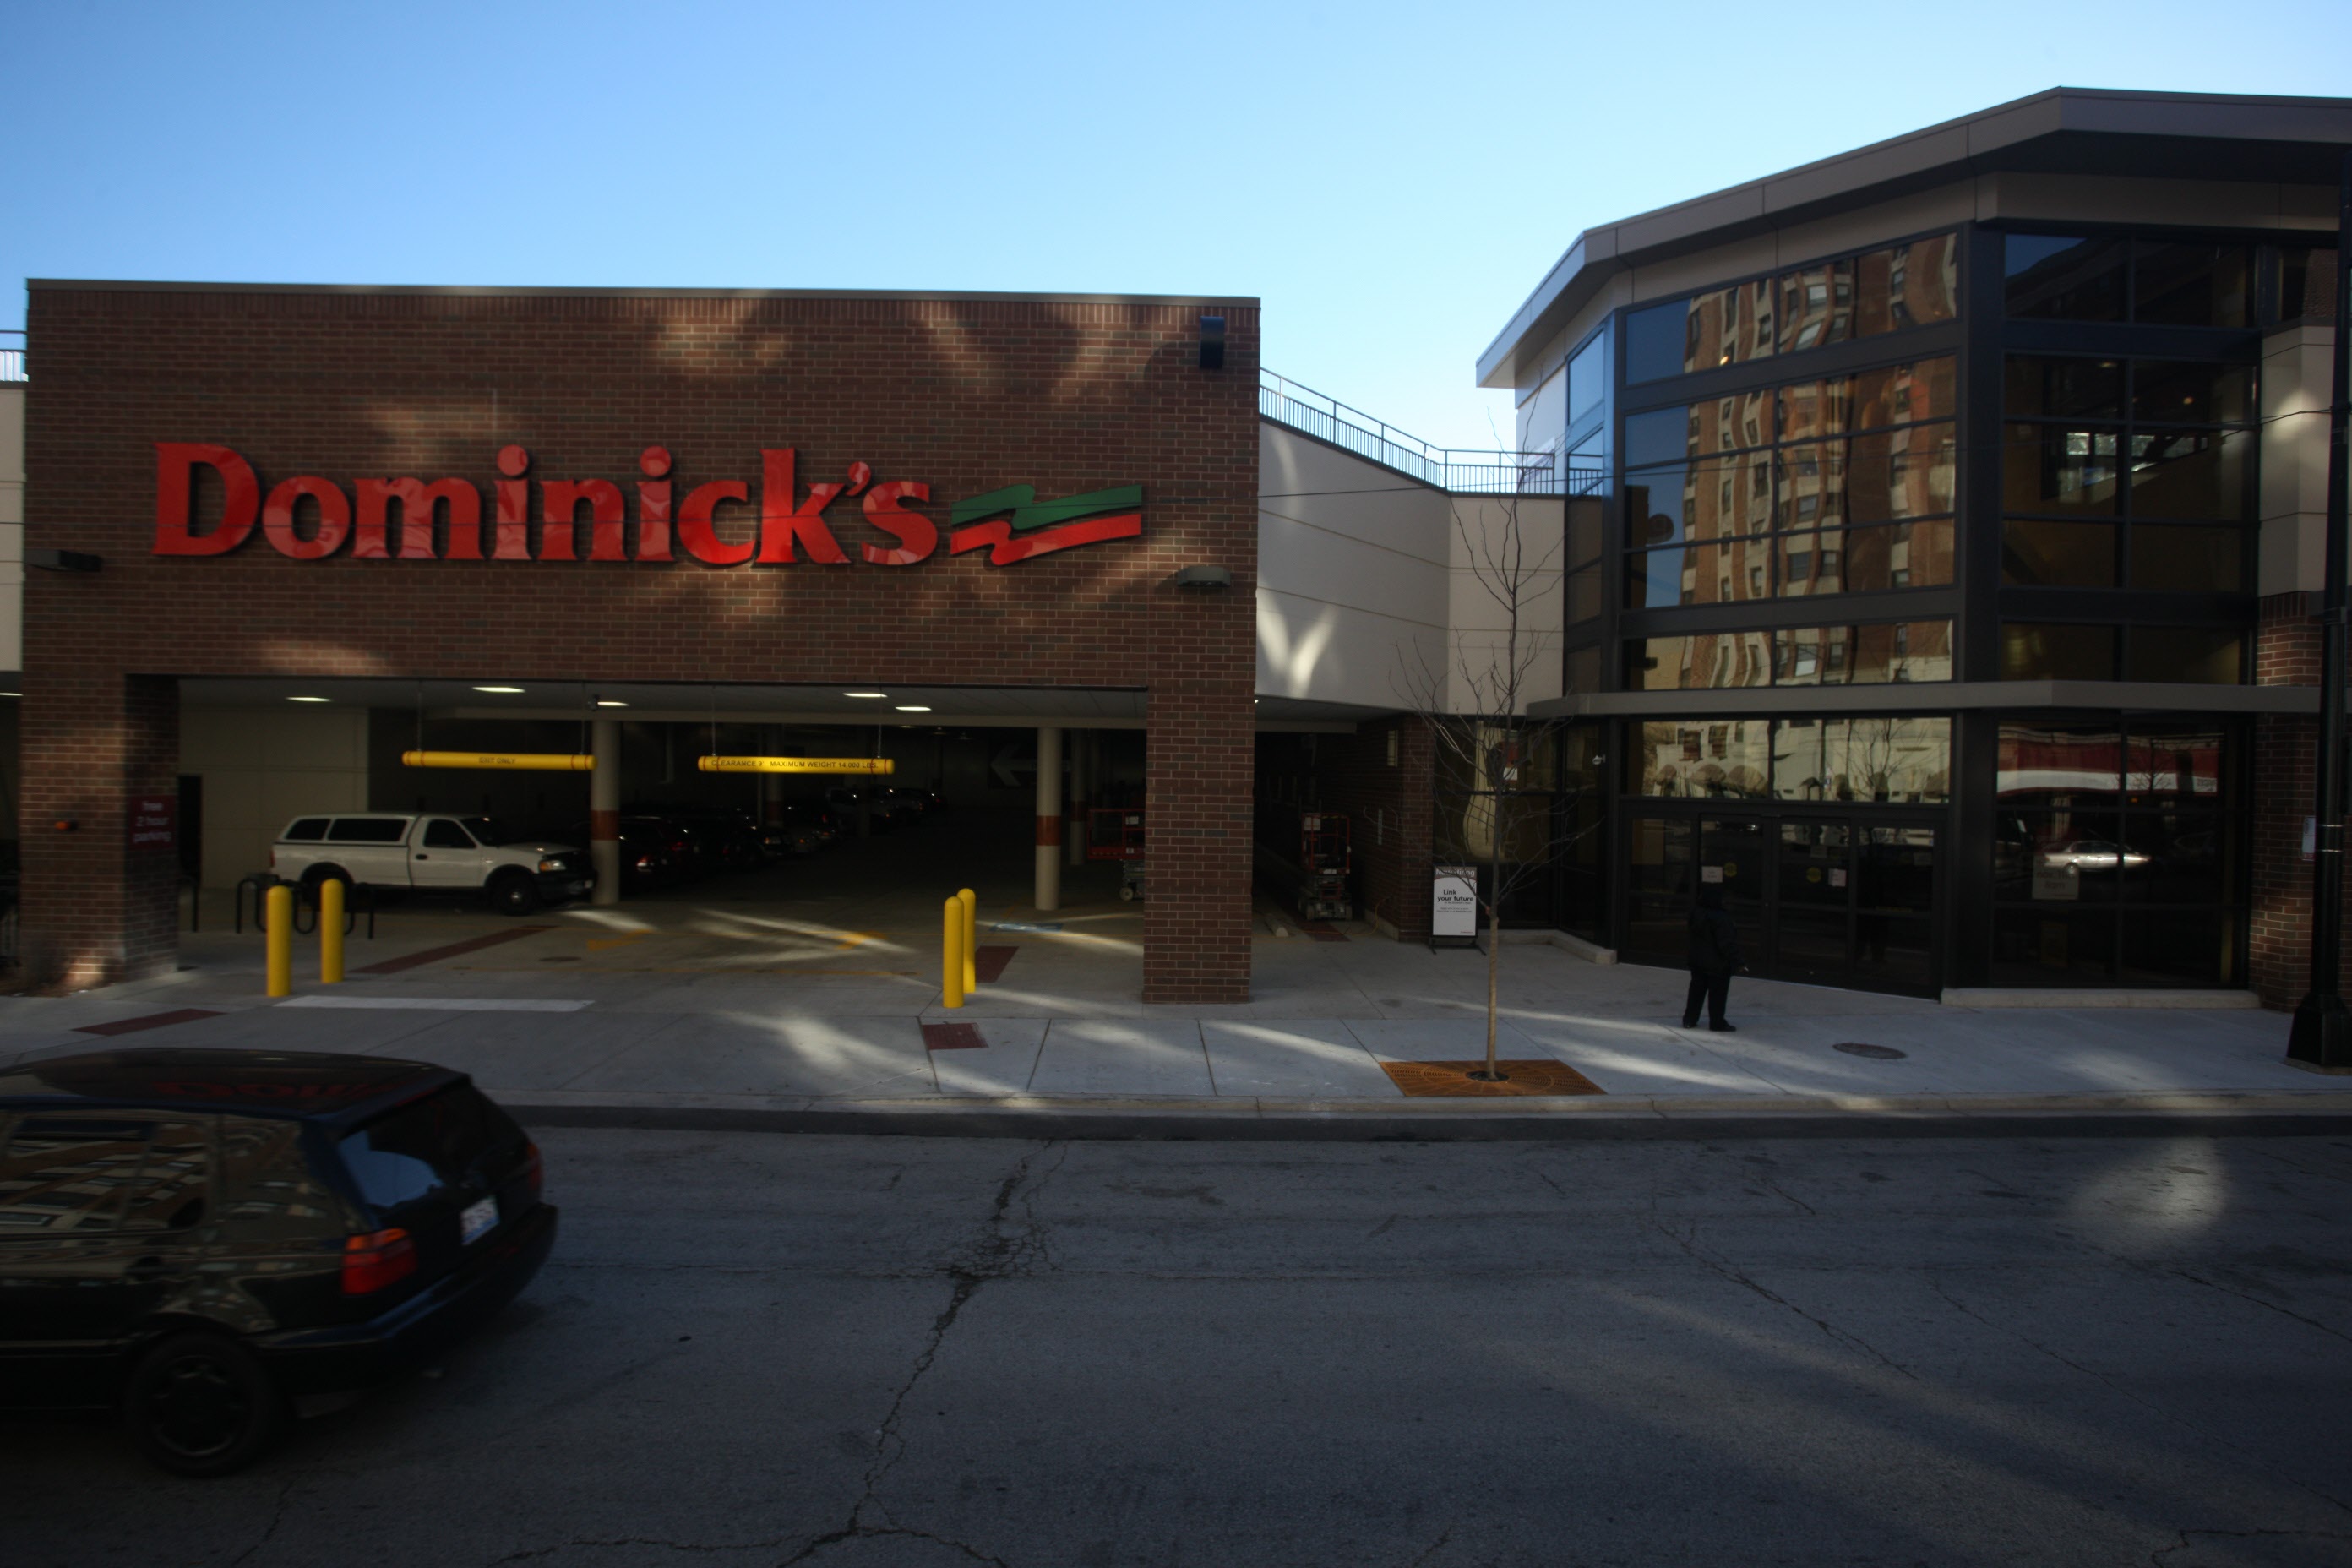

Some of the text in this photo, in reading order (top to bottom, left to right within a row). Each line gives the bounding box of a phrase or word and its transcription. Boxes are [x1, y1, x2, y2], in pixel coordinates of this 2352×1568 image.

[151, 441, 939, 567] Dominick's
[135, 815, 170, 827] 2 hour
[133, 830, 172, 844] parking
